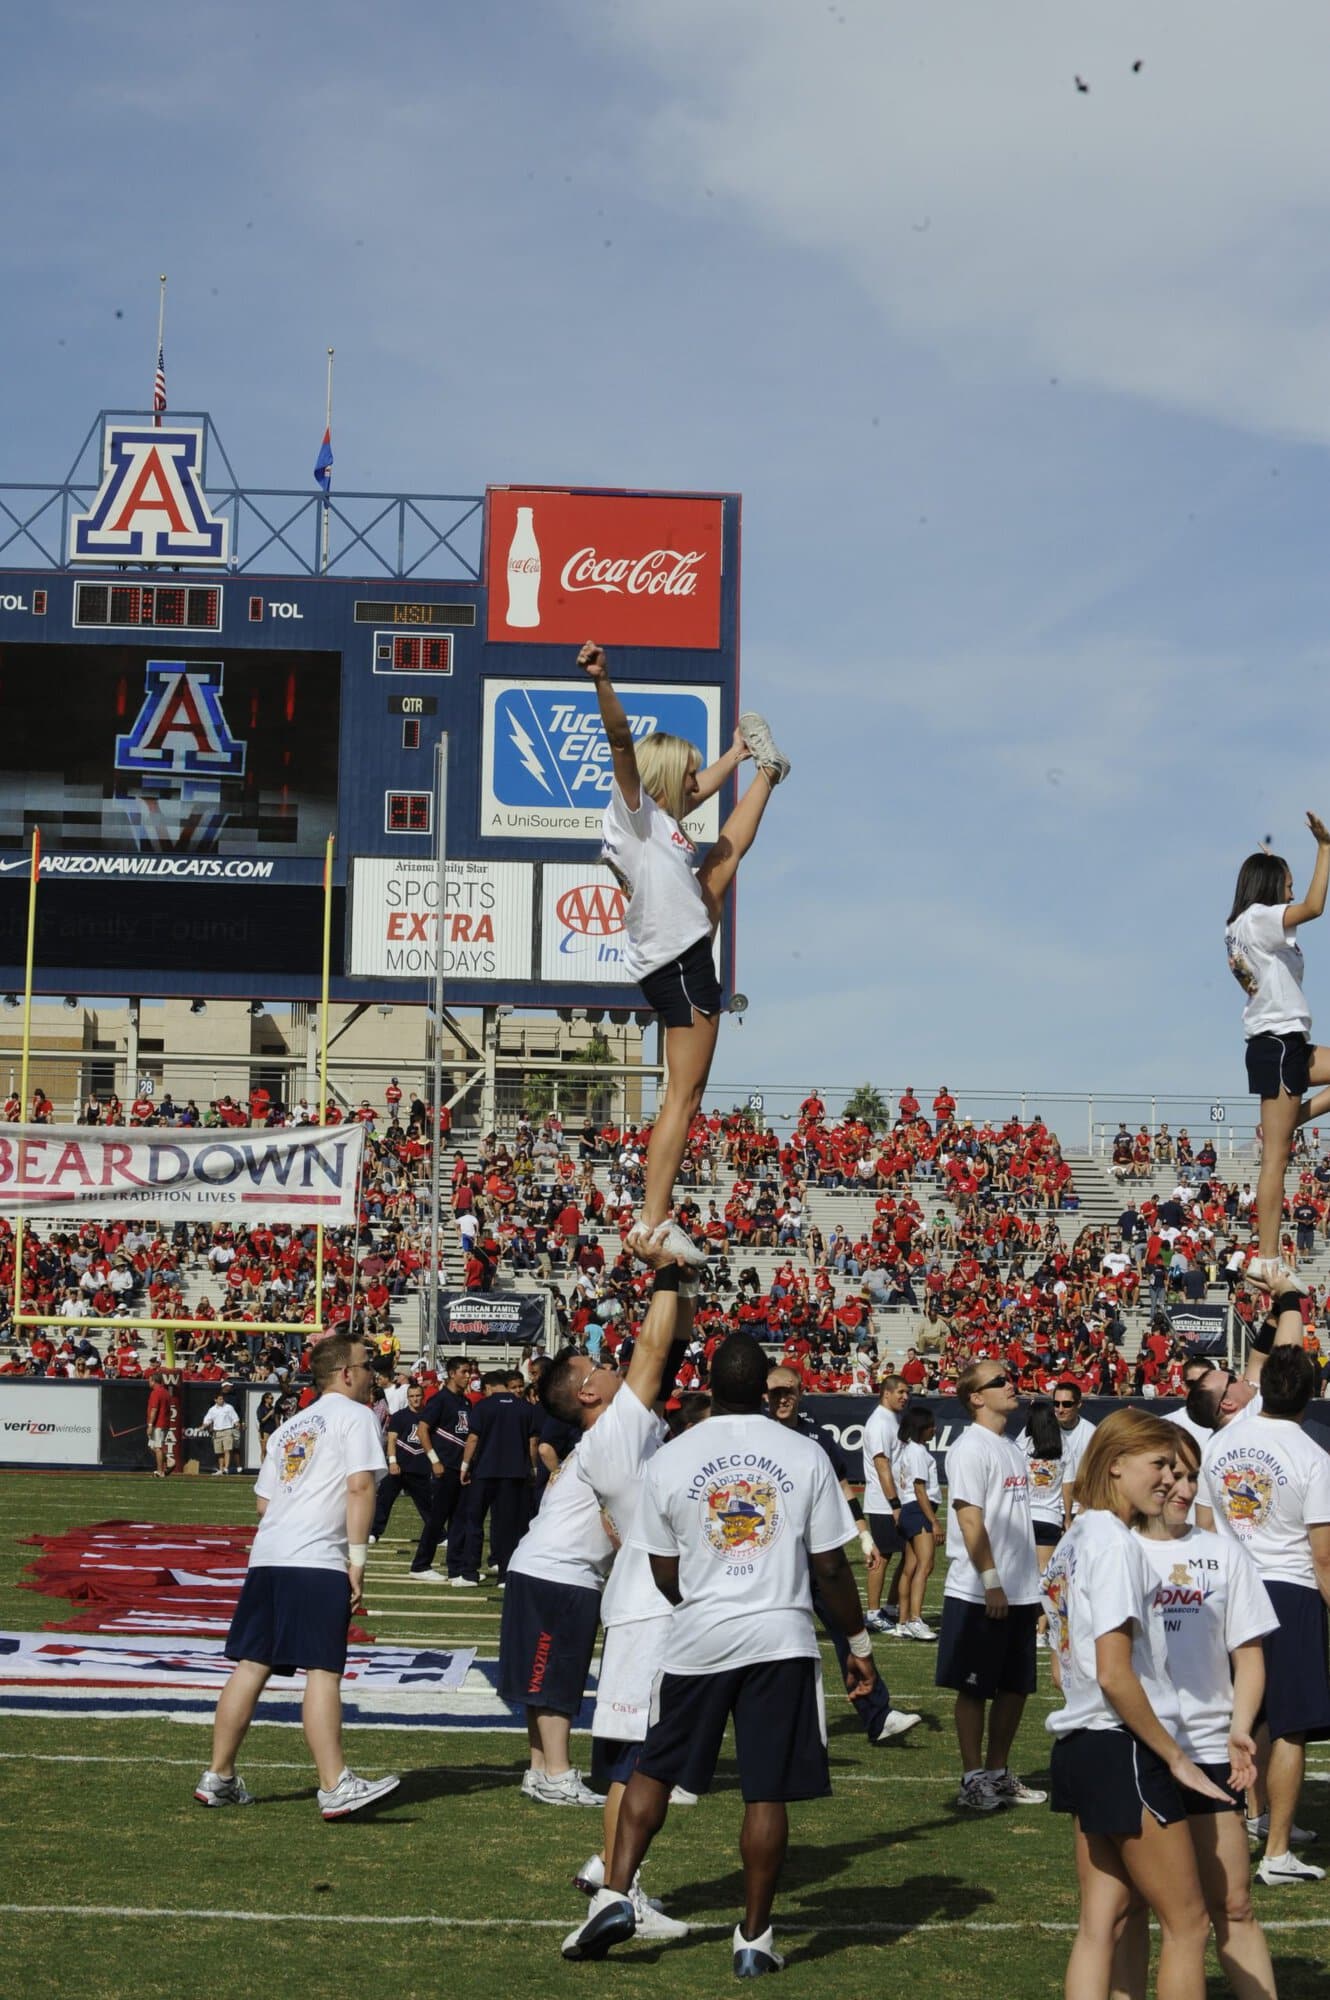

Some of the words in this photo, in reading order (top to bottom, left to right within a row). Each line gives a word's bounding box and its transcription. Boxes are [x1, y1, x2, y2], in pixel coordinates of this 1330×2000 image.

[71, 427, 228, 563] A
[560, 546, 706, 596] Coca-Cola
[268, 602, 304, 619] TOL
[393, 604, 433, 624] WSU
[402, 697, 423, 713] QTR
[492, 814, 503, 826] A
[507, 814, 580, 828] UniSource
[38, 855, 274, 878] ARIZONAWILDCATS.COM
[395, 861, 435, 873] Arizona
[437, 862, 464, 875] aily
[466, 862, 488, 874] Star
[385, 880, 495, 909] SPORTS
[386, 912, 495, 943] EXTRA
[386, 949, 496, 973] MONDAYS
[140, 1080, 153, 1094] 28
[750, 1096, 762, 1109] 29
[1211, 1107, 1224, 1121] 30
[80, 1191, 107, 1202] THE
[111, 1191, 192, 1203] TRADITION
[197, 1191, 237, 1204] LIVES
[450, 1304, 490, 1313] AMERICAN
[492, 1305, 520, 1313] FAMILY
[1210, 1447, 1288, 1487] HOMECOMING
[687, 1454, 794, 1501] HOMECOMING
[726, 1564, 754, 1576] 2009
[528, 1631, 553, 1693] ARIZONA
[612, 1702, 638, 1715] Cats
